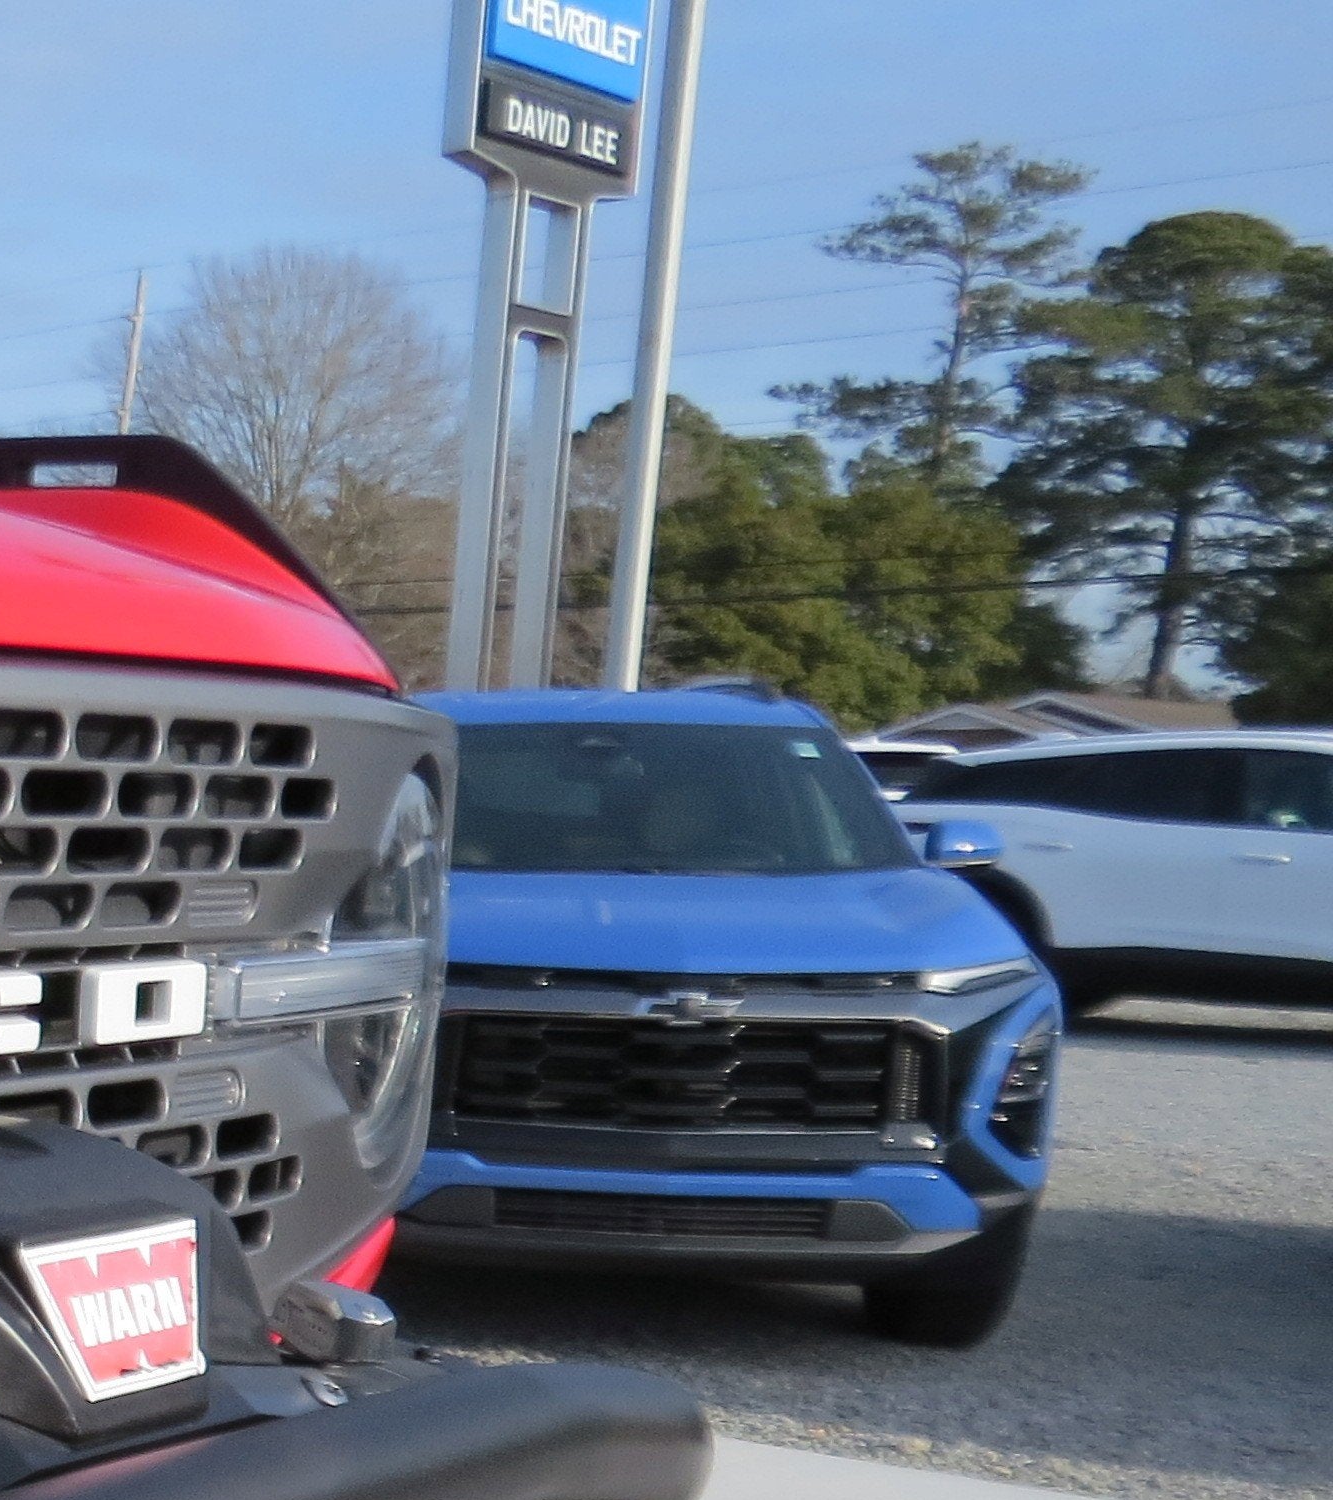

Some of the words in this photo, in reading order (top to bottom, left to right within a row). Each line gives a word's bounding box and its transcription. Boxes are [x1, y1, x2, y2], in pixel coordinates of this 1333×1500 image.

[505, 0, 642, 66] CHEVROLET
[507, 98, 571, 149] DAVID
[582, 120, 619, 165] LEE
[70, 1277, 188, 1347] WARN
